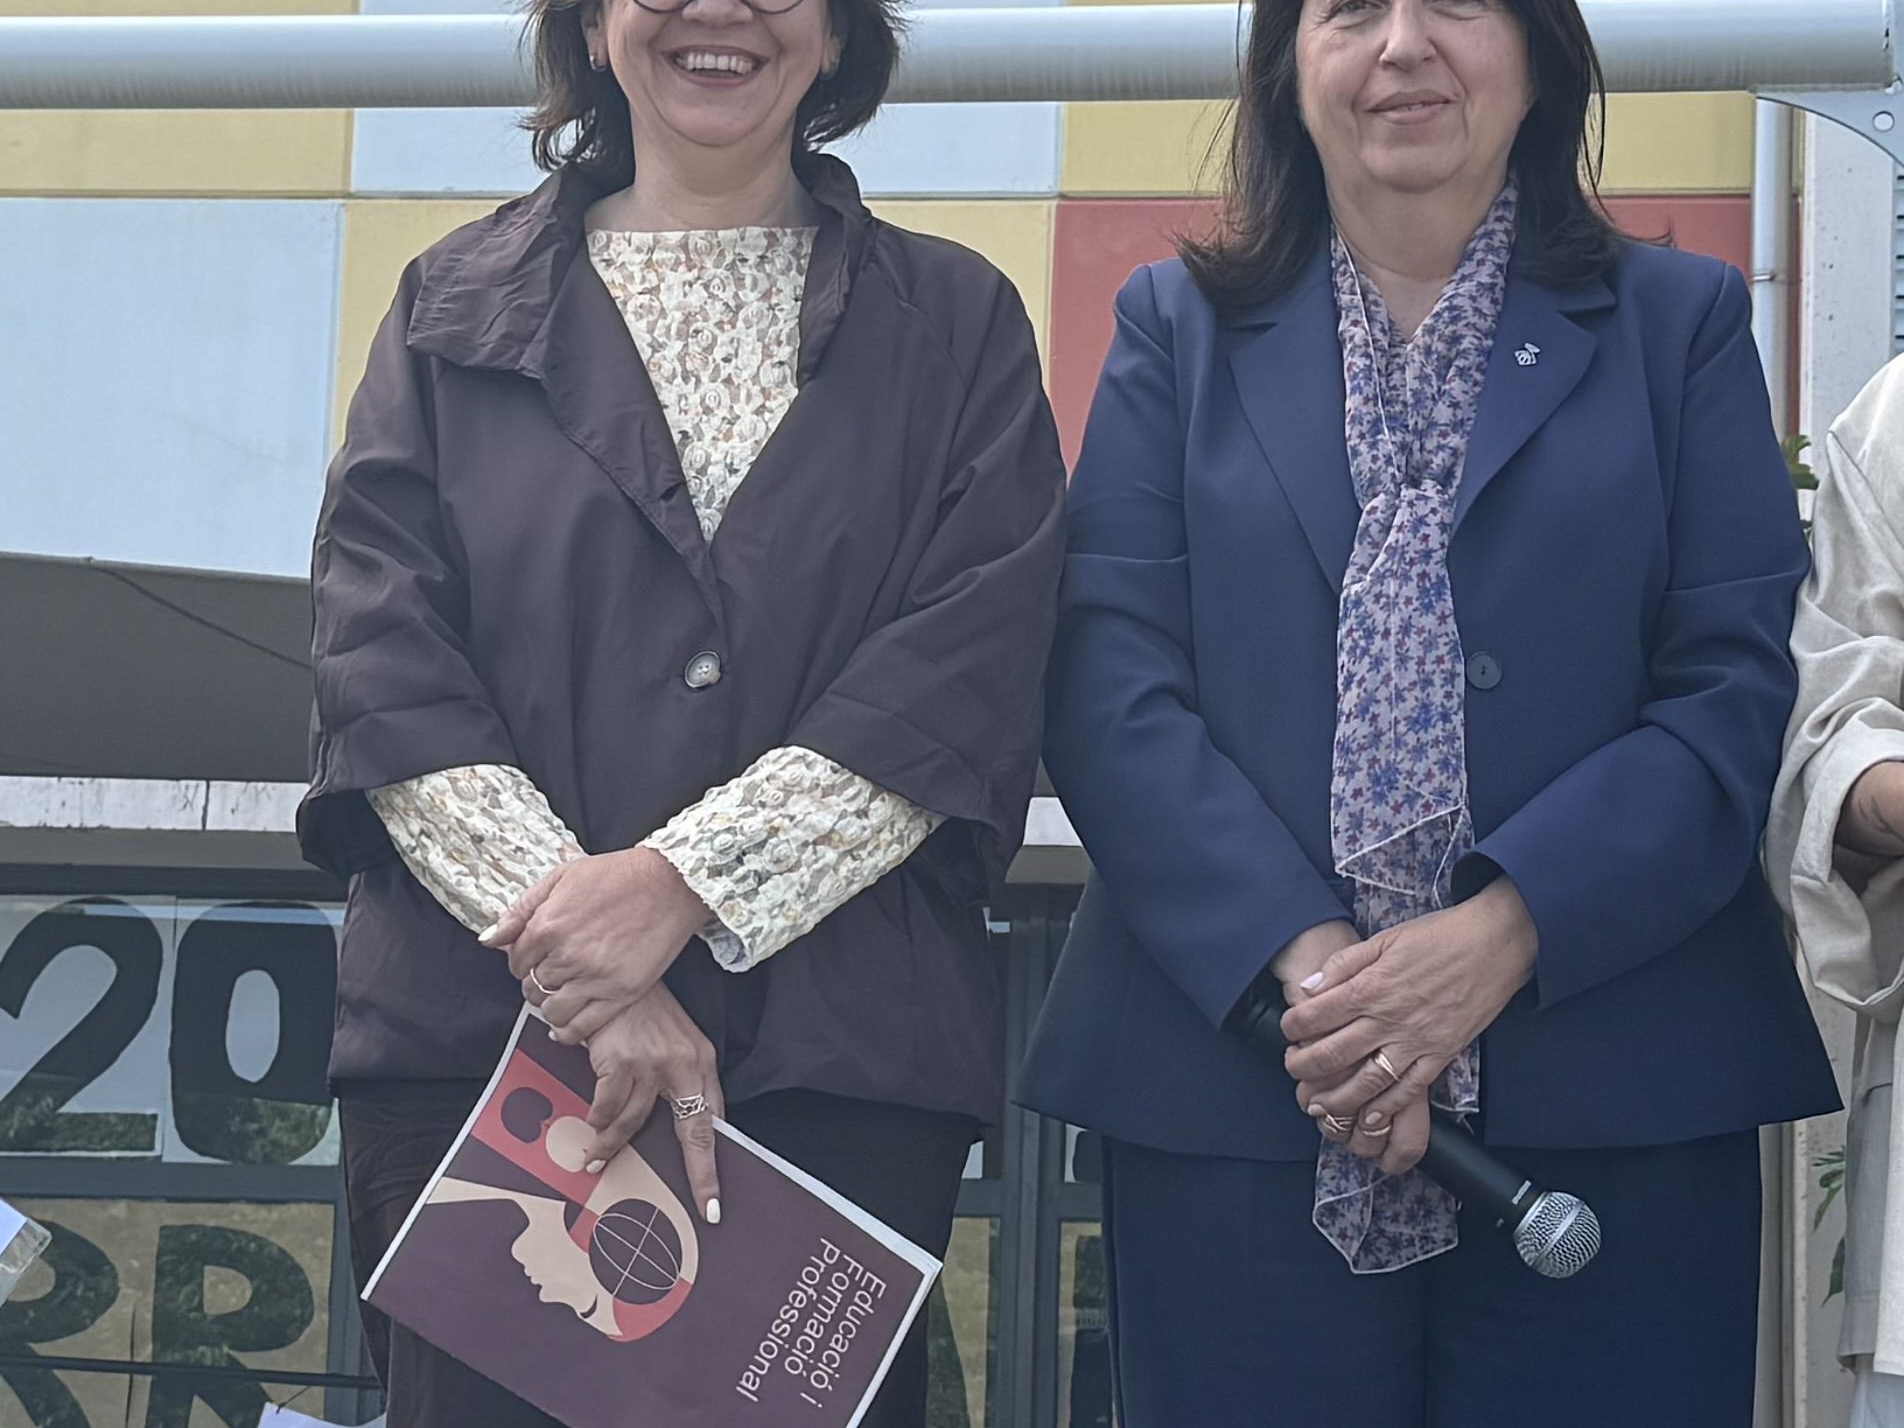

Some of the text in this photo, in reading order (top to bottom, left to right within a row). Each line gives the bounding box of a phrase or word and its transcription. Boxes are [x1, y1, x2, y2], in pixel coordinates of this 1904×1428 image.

[736, 1237, 841, 1403] Professional
[784, 1254, 864, 1378] Formació
[800, 1271, 887, 1409] Educació i
